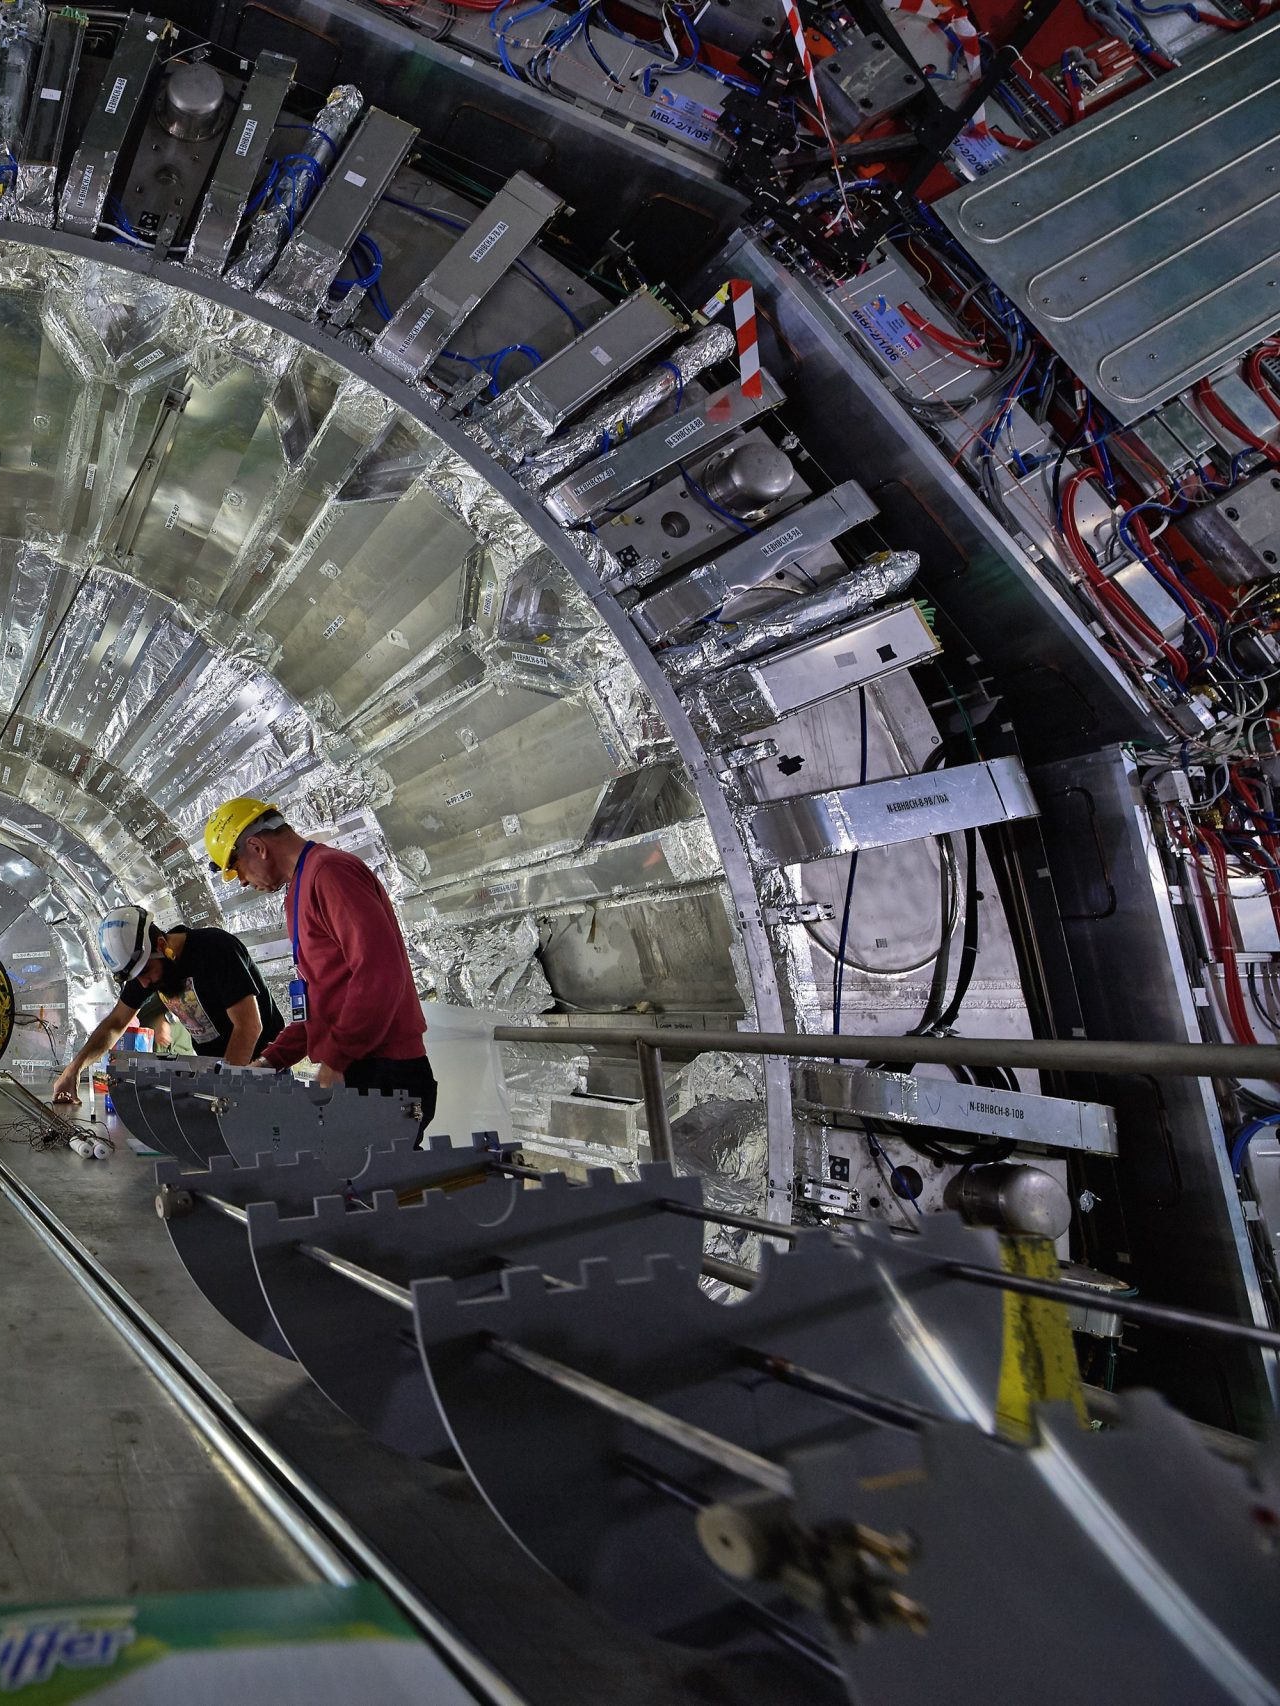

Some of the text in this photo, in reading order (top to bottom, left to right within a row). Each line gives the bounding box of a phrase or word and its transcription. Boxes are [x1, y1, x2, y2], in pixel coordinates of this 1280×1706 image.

[650, 110, 709, 142] MB/-2/1/05
[852, 310, 898, 361] MB/-2/1/06
[886, 794, 949, 814] N-EBHBCH-8-9B/10A
[969, 1101, 1024, 1119] N-EBHBCH-8-10B
